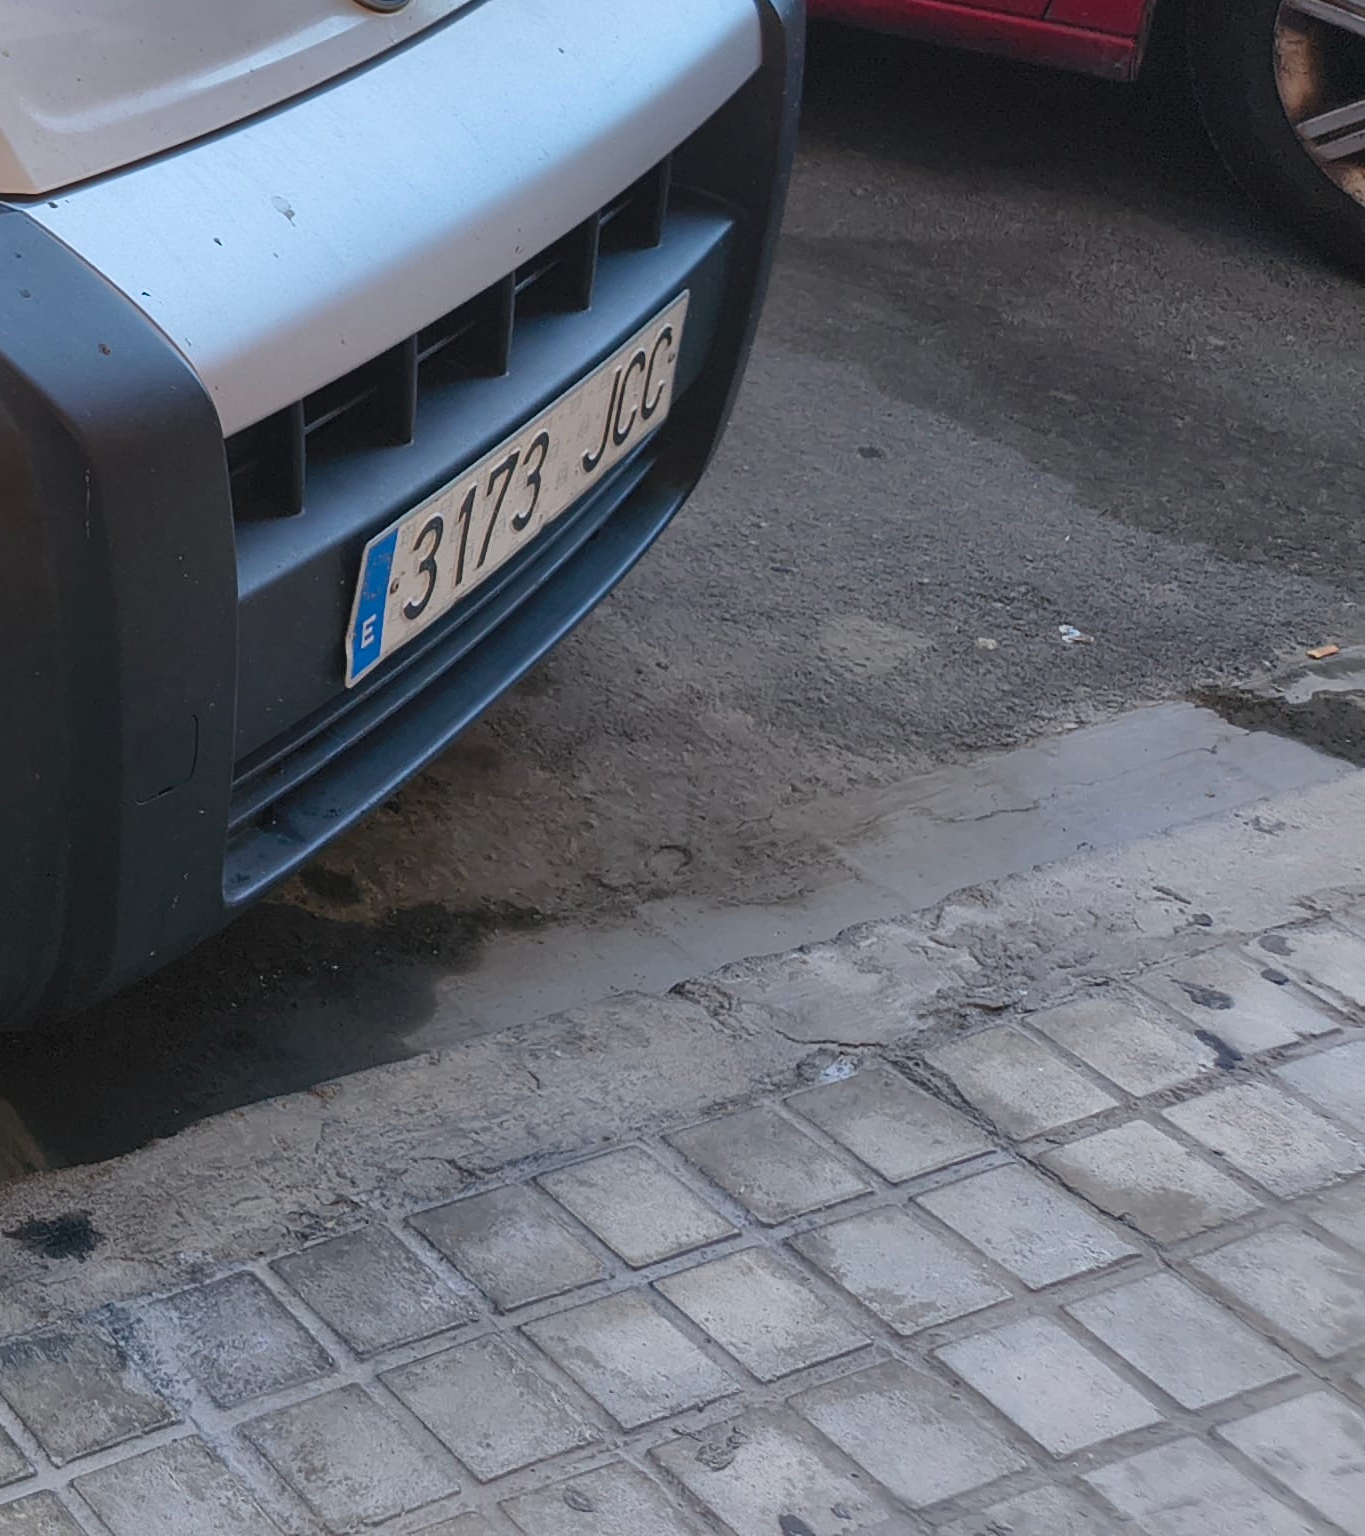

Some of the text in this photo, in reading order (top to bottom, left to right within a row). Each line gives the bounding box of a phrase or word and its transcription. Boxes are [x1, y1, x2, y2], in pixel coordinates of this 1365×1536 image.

[403, 323, 673, 621] 3173 JCC
[360, 614, 376, 648] E
